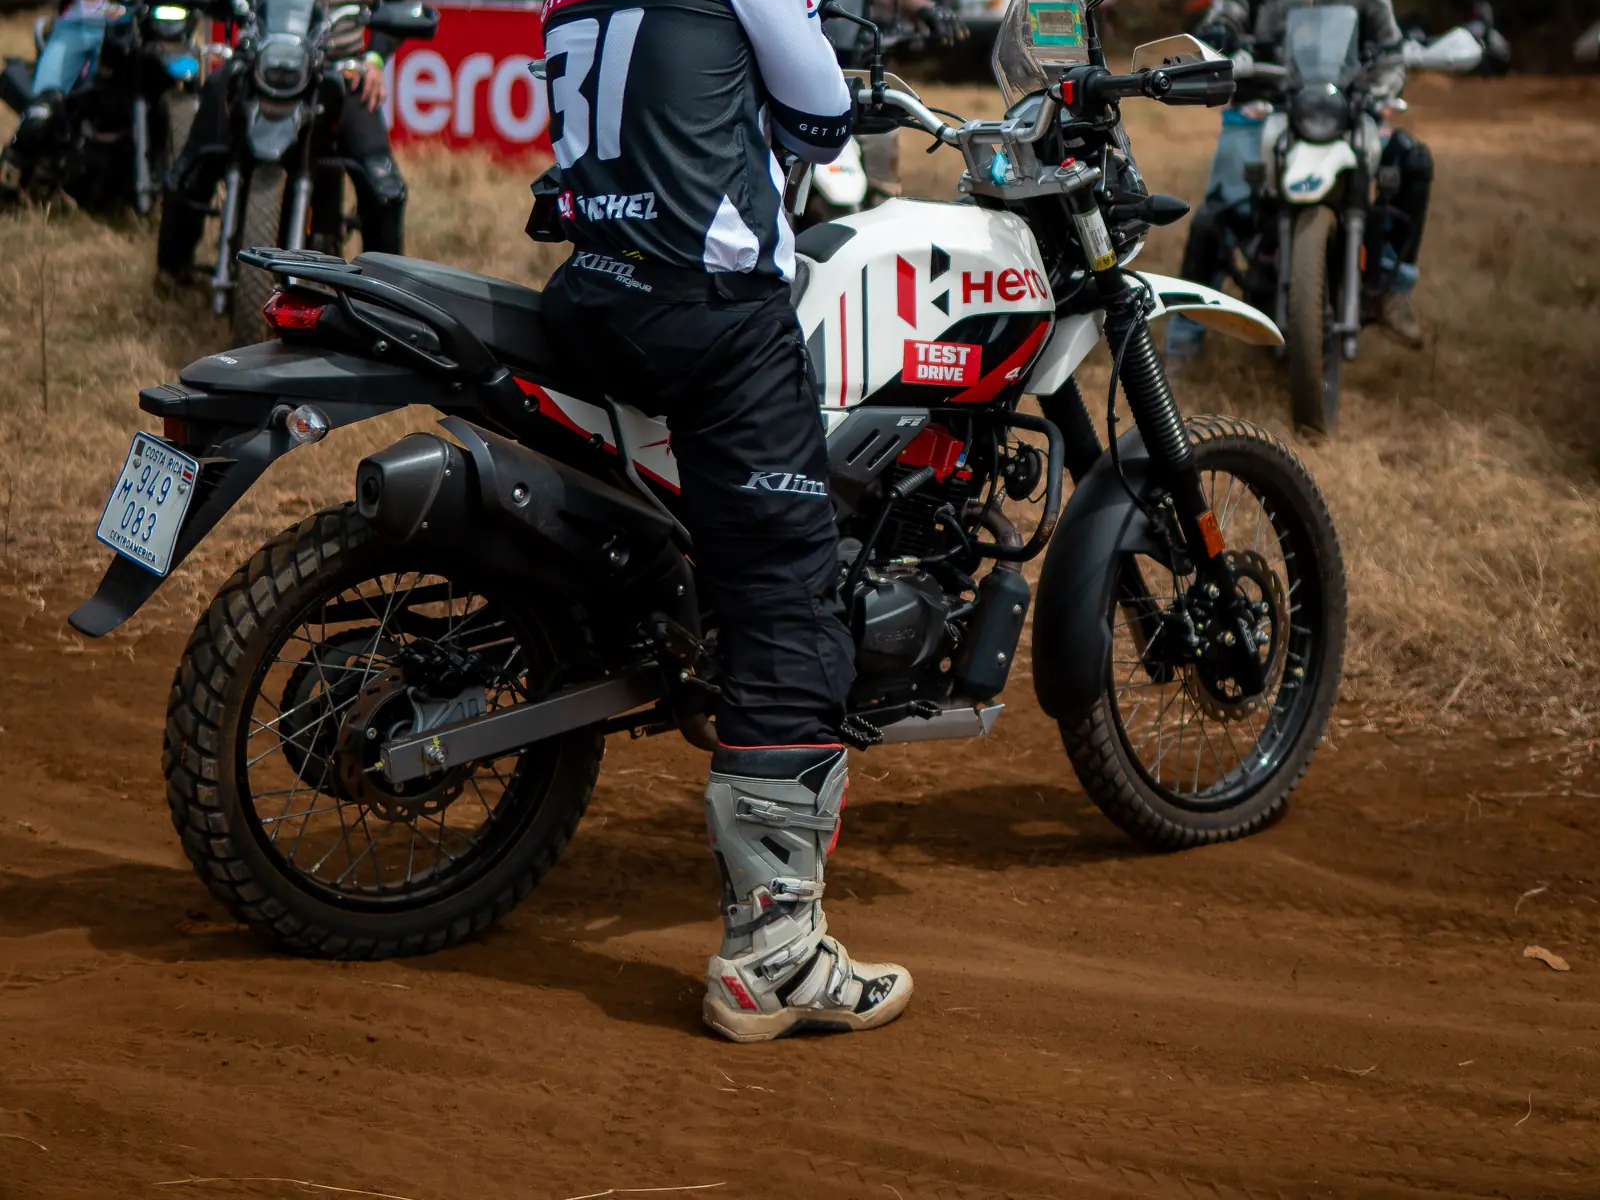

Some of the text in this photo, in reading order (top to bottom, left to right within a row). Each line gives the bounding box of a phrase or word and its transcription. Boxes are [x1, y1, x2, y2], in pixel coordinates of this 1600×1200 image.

[545, 7, 645, 170] 31
[799, 123, 848, 137] GET IN
[962, 267, 1049, 303] Hero
[915, 342, 971, 366] TEST
[917, 364, 964, 382] DRIVE
[145, 445, 184, 476] COSTA RICA
[117, 464, 173, 505] M 949
[121, 500, 157, 542] 083
[109, 529, 157, 565] CENTROAMERICA
